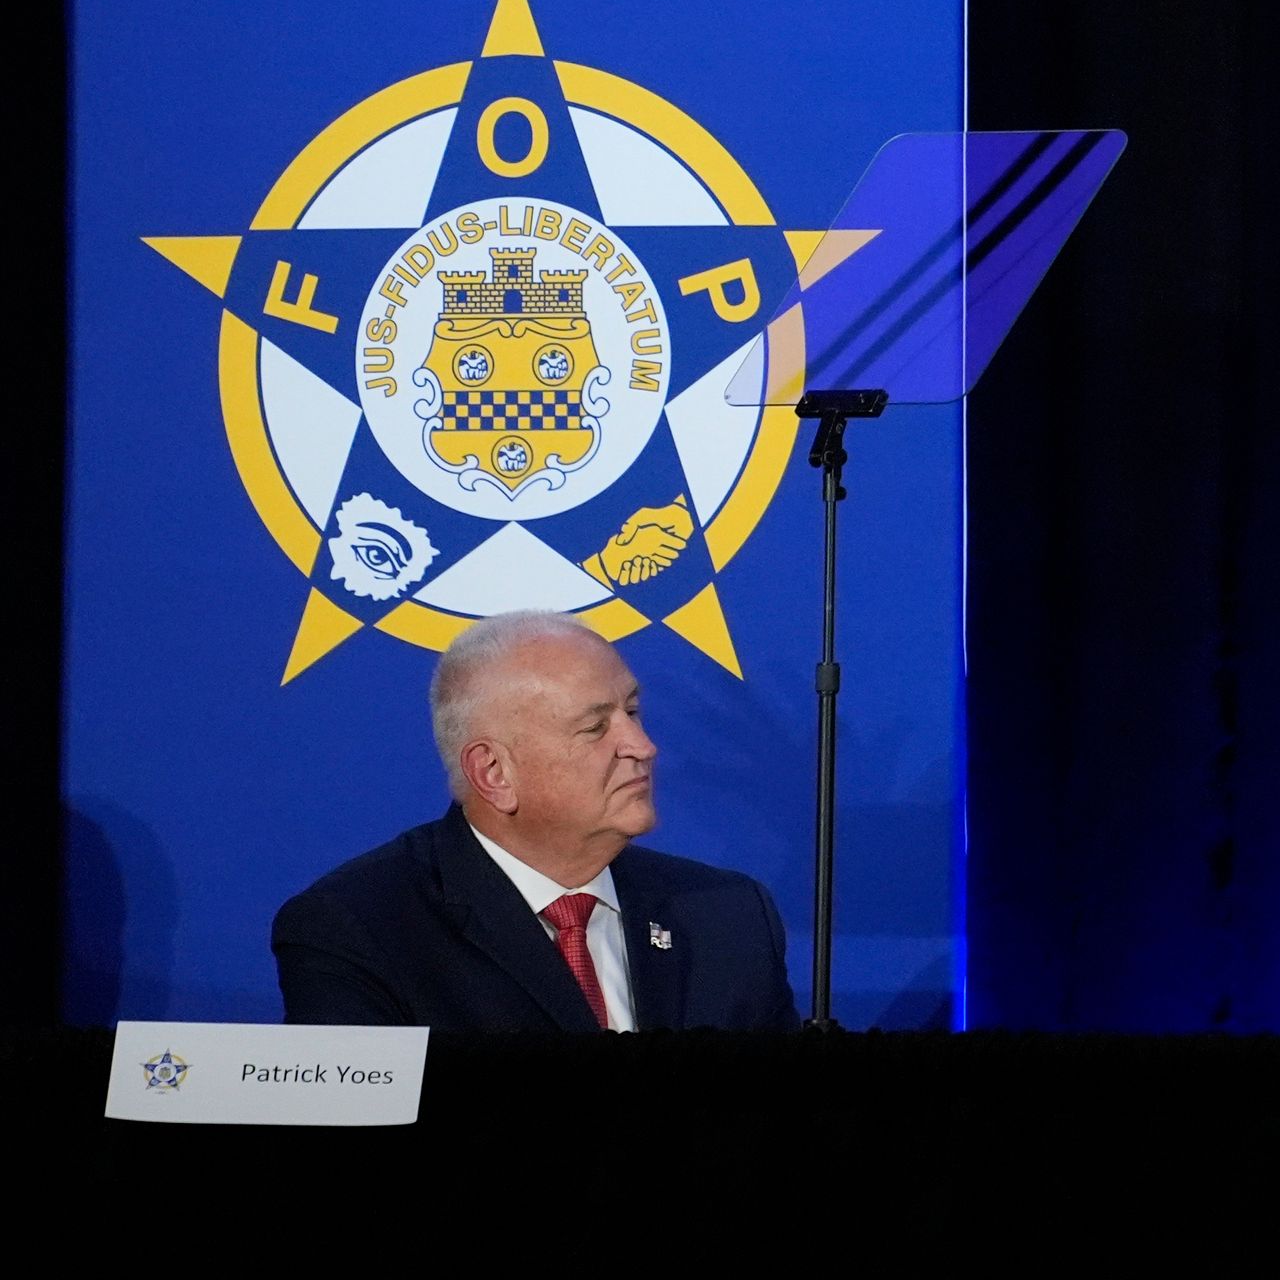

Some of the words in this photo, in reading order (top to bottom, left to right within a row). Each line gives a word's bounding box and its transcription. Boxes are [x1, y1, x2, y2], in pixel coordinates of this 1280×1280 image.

[262, 259, 341, 336] F
[475, 96, 550, 179] O
[677, 256, 763, 325] P
[363, 204, 663, 399] JUS-FIDUS-LIBERTATUM
[241, 1063, 329, 1084] Patrick
[336, 1065, 394, 1085] Yoes
